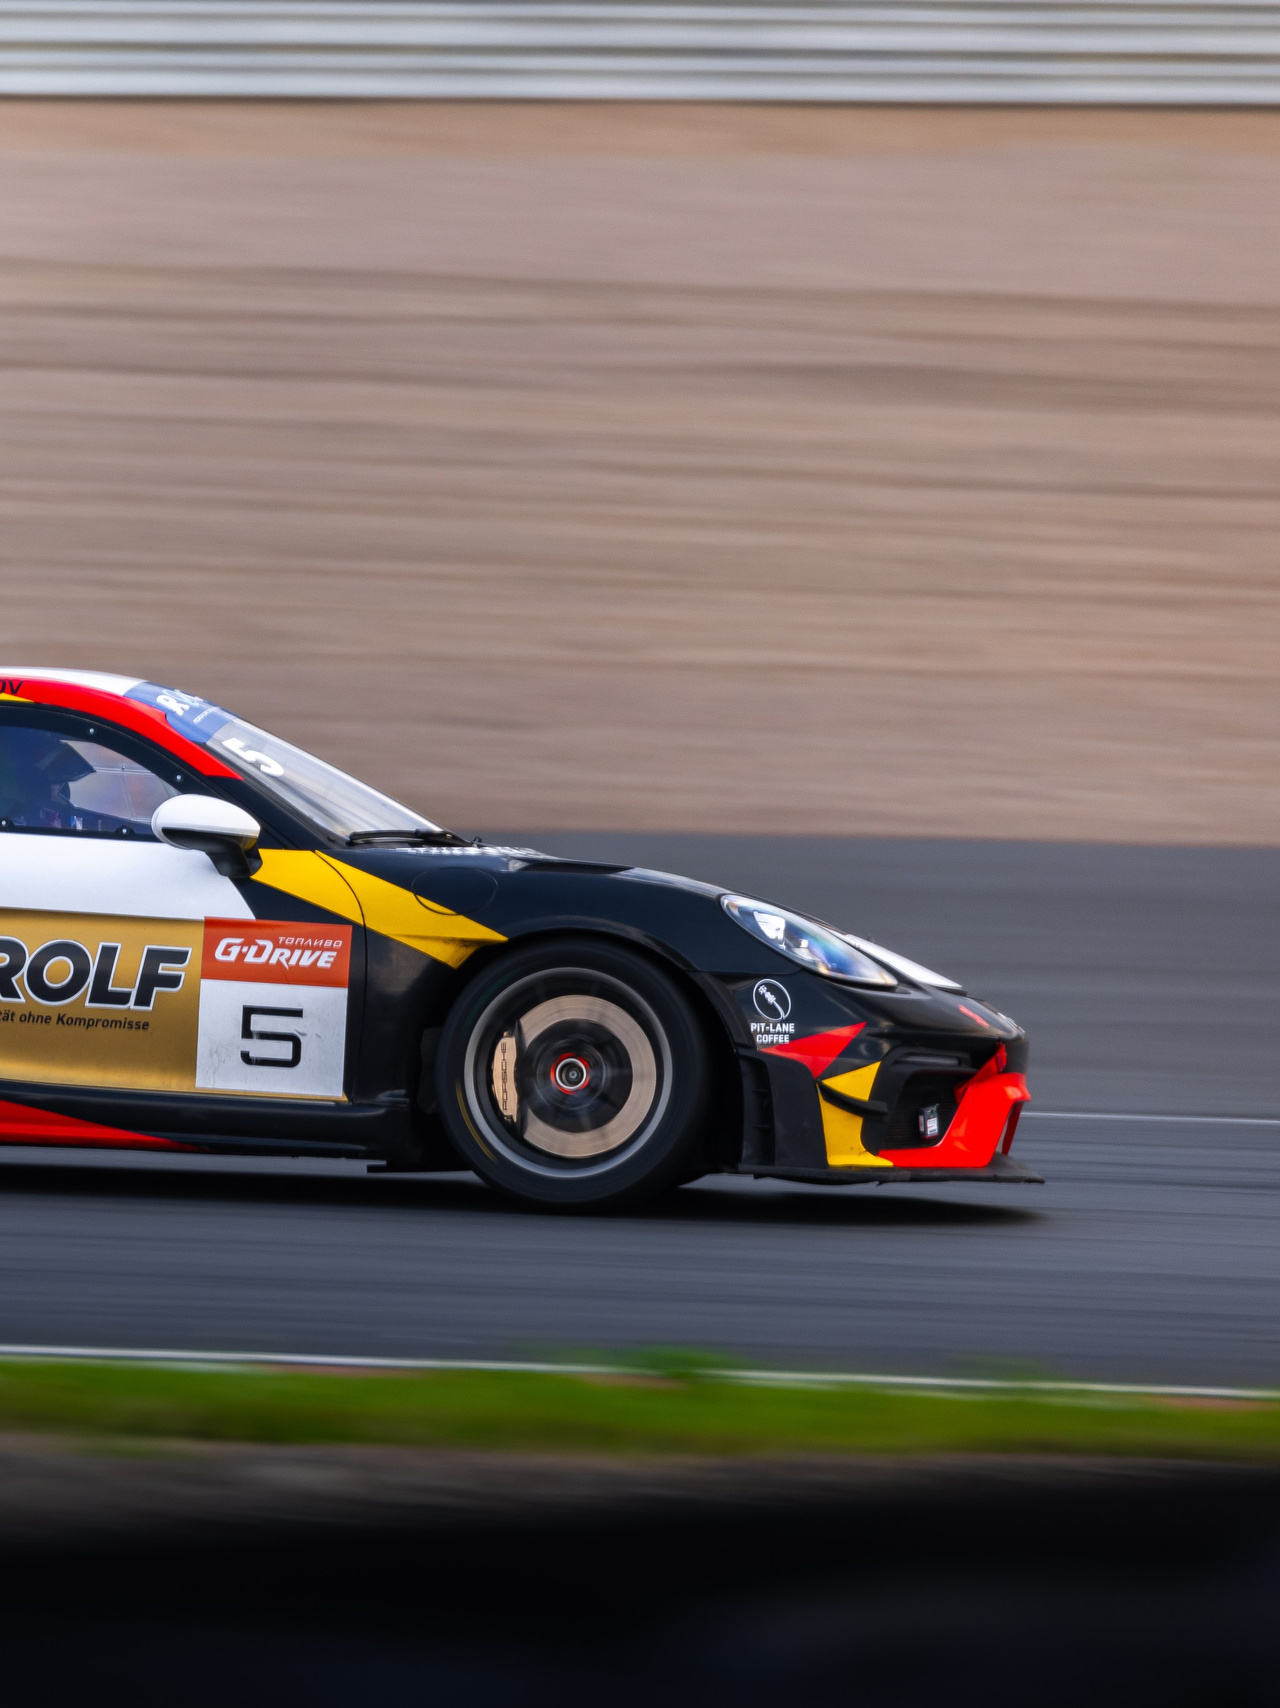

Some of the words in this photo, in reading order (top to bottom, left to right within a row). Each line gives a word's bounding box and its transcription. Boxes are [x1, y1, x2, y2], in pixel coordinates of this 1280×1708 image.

[222, 737, 284, 778] 5
[278, 936, 343, 948] ТОПЛИВО
[19, 1012, 52, 1025] ohne
[56, 1013, 150, 1031] Kompromisse
[750, 1022, 795, 1034] PIT-LANE
[240, 1004, 304, 1068] 5
[756, 1034, 790, 1045] COFFEE
[500, 1041, 508, 1111] PORSCHE
